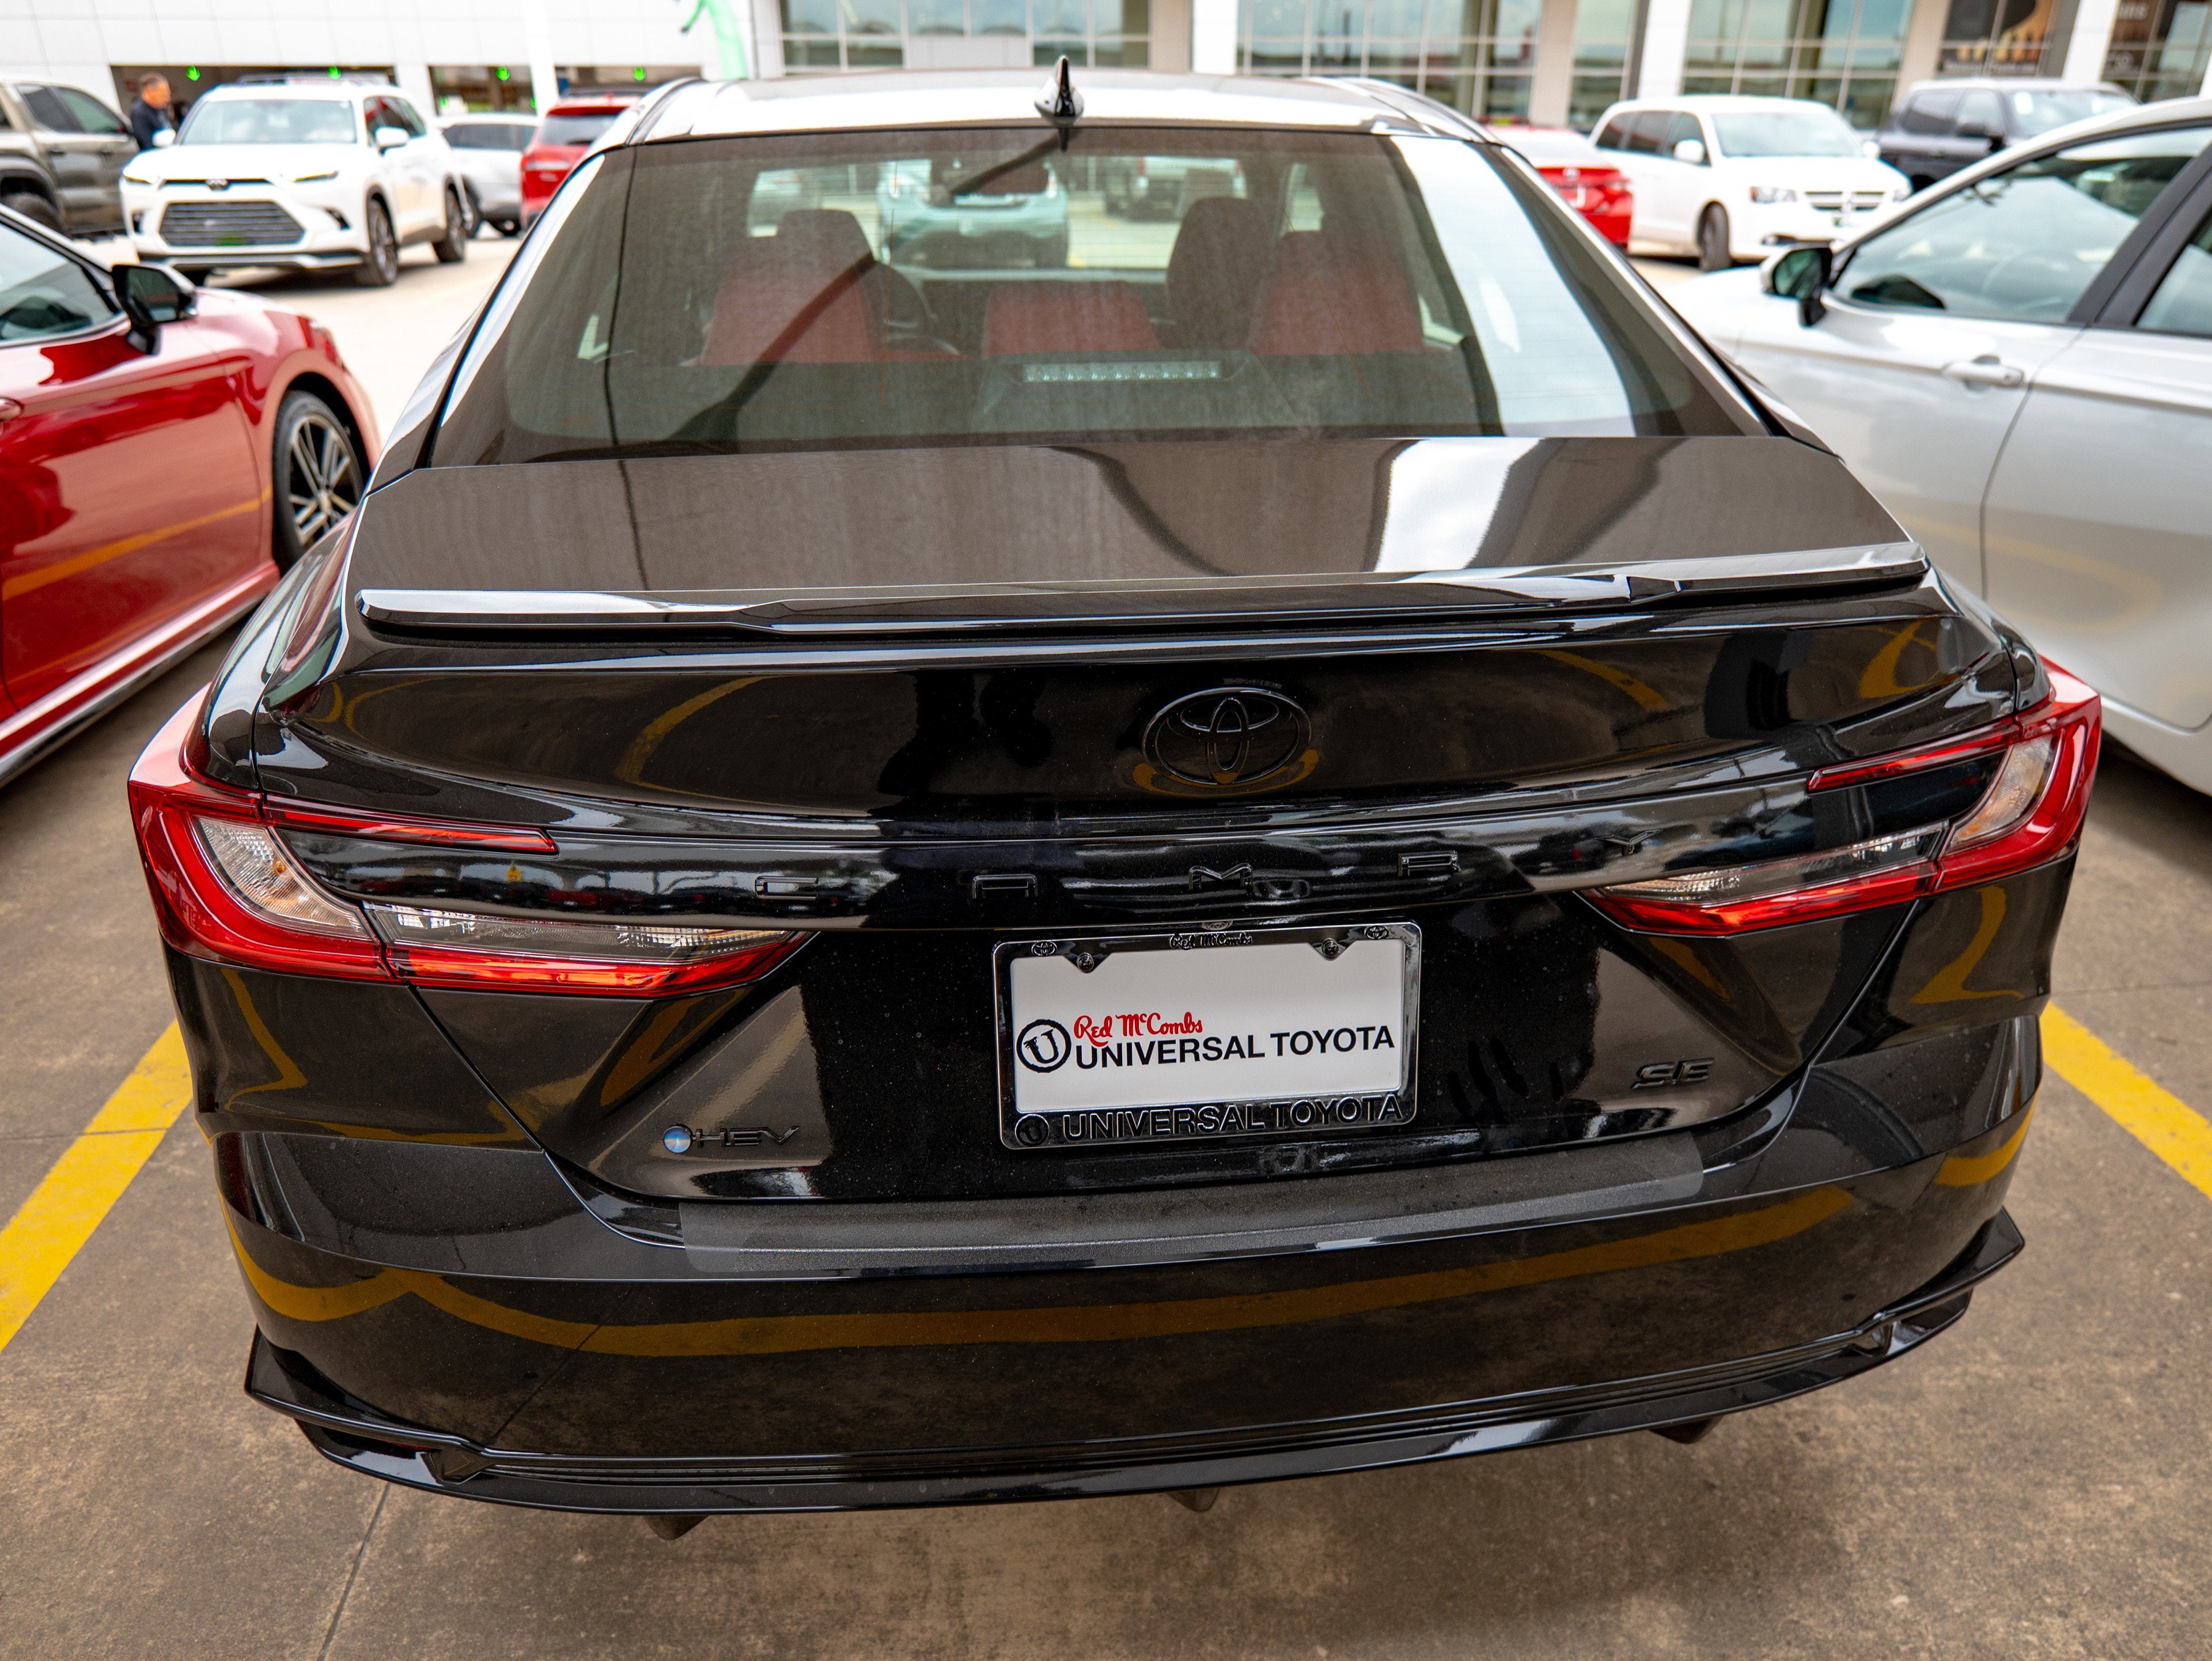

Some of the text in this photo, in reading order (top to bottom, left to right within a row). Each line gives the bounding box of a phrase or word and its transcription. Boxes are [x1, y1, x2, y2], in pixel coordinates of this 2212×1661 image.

[1169, 933, 1195, 950] Red
[1074, 1012, 1203, 1047] Red McCombs
[1076, 1026, 1395, 1070] UNIVERSAL TOYOTA
[1630, 1057, 1715, 1089] SE
[1063, 1094, 1403, 1141] UNIVERSAL TOYOTA
[693, 1125, 800, 1148] HEV
